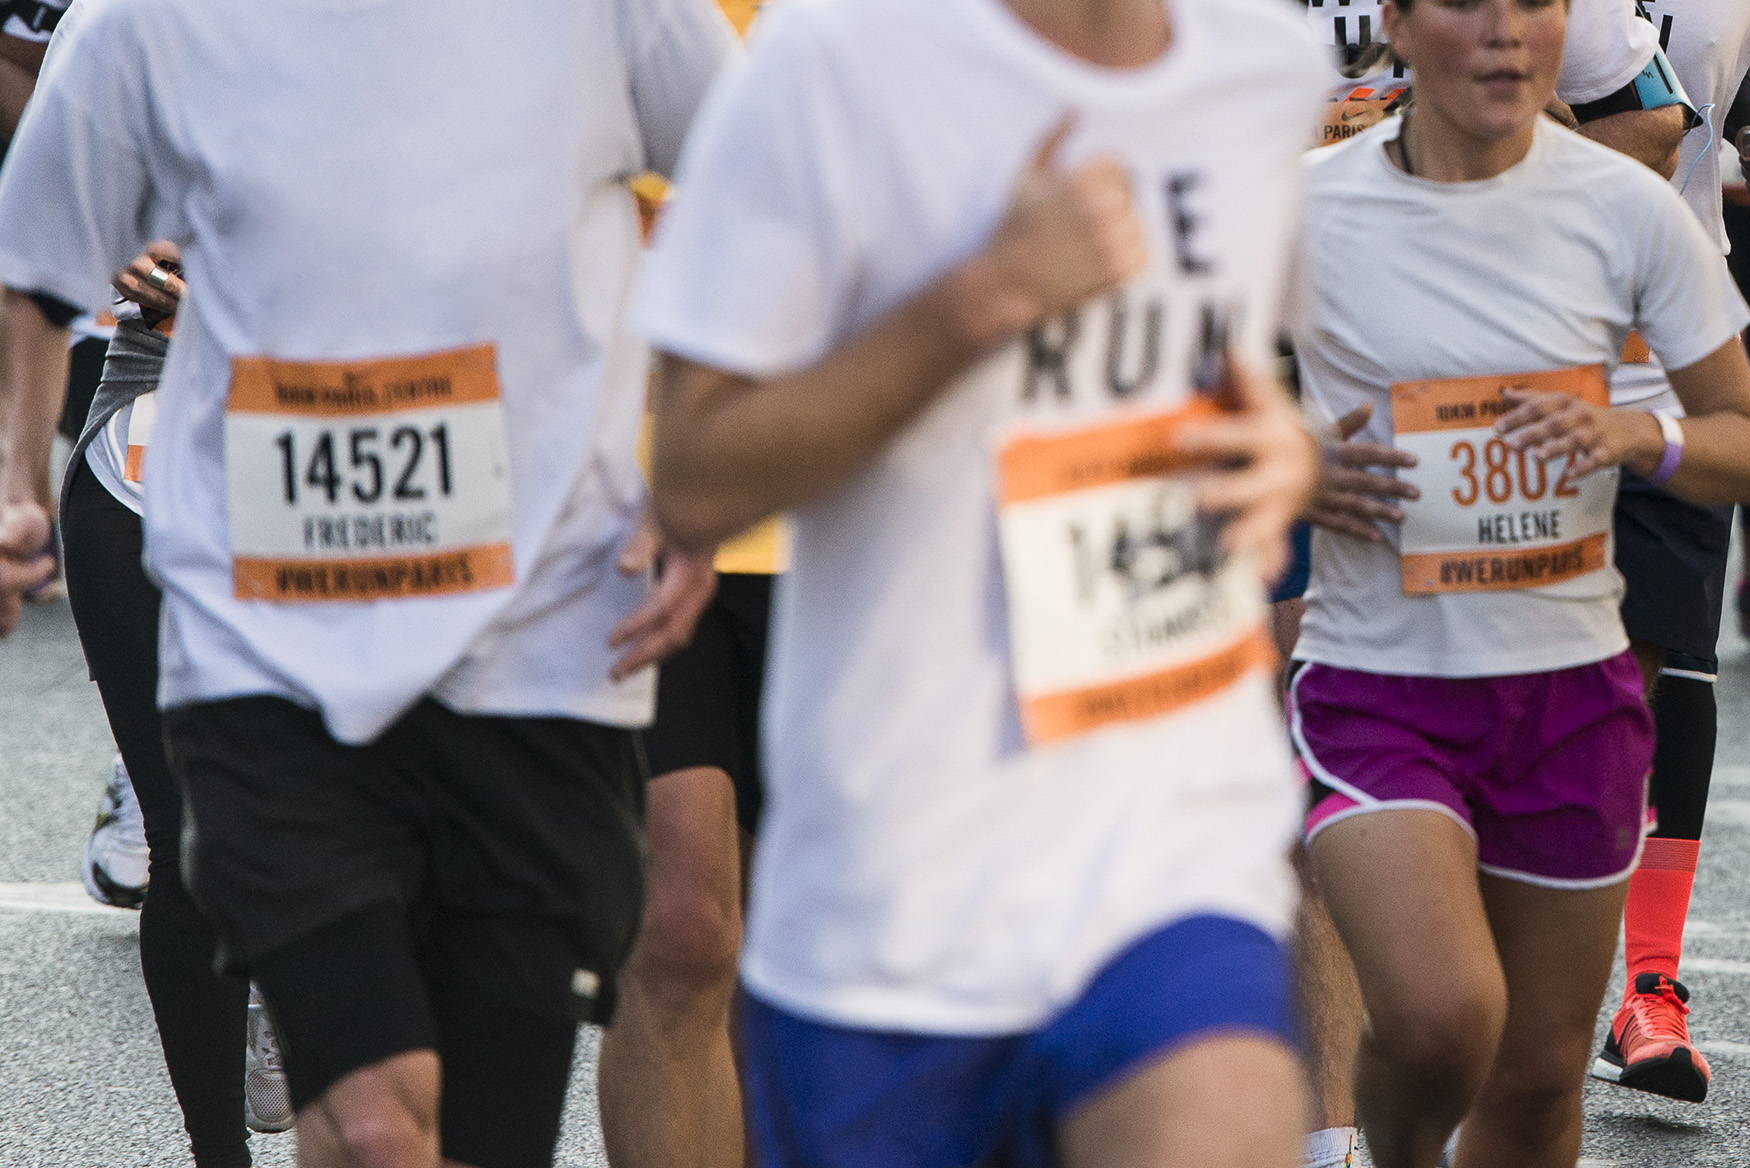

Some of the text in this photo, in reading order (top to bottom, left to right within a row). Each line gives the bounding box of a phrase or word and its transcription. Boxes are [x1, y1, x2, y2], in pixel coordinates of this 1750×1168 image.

[1164, 169, 1220, 276] E
[275, 421, 455, 508] 14521
[1450, 438, 1580, 508] 3802
[303, 512, 438, 550] FREDERIC
[1477, 509, 1562, 545] HELENE
